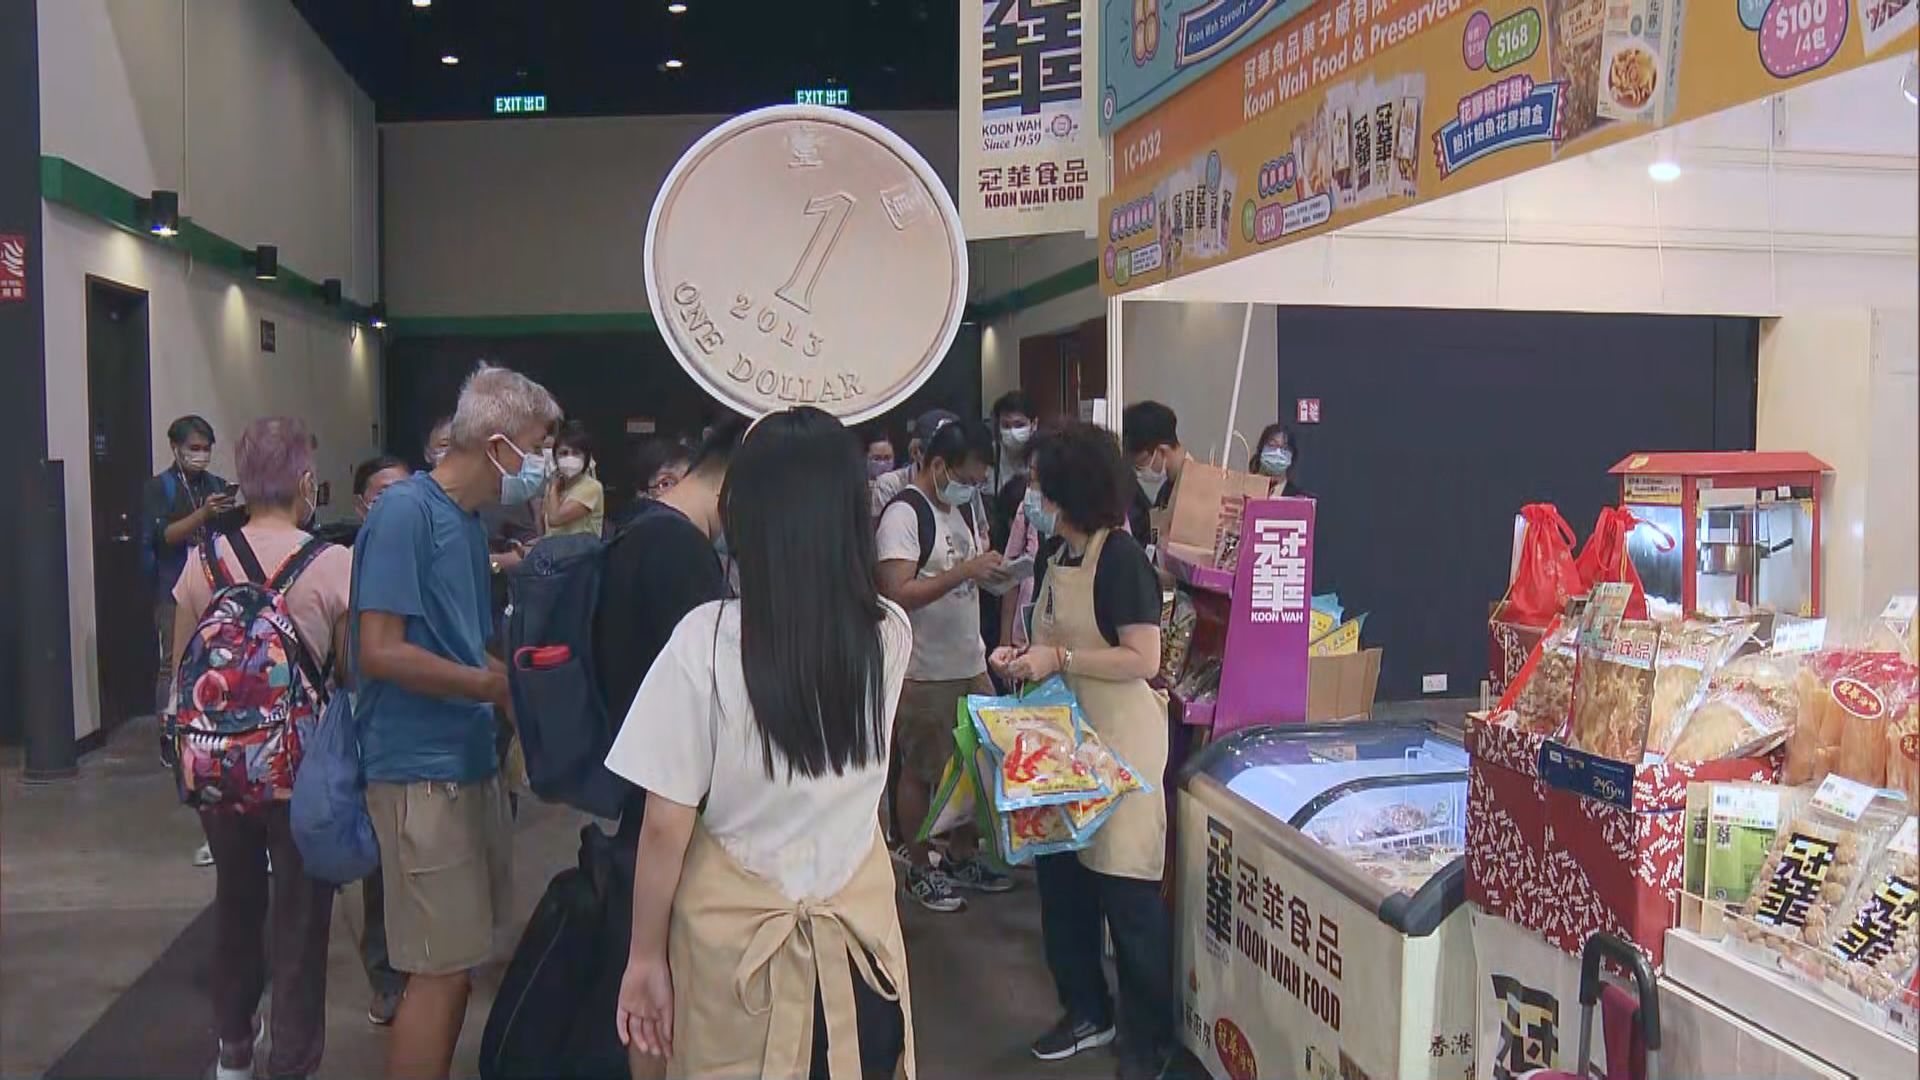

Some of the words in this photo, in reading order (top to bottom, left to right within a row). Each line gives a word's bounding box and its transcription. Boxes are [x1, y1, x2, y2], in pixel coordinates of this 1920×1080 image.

[1775, 0, 1828, 40] $100
[1497, 24, 1529, 57] $168
[1244, 88, 1274, 121] Koon
[1278, 64, 1308, 102] Wah
[1312, 38, 1347, 86] Food
[1353, 34, 1364, 62] &
[496, 96, 521, 113] EXIT
[524, 96, 545, 111] 出口
[797, 90, 823, 104] EXIT
[826, 90, 848, 104] 出口
[982, 121, 1013, 137] KOON
[1016, 118, 1041, 132] WAH
[983, 137, 1010, 151] Since
[1014, 132, 1041, 148] 1959
[978, 158, 1088, 192] 冠華食品
[985, 190, 1017, 209] KOON
[1020, 187, 1049, 206] WAH
[1052, 185, 1084, 203] FOOD
[775, 192, 857, 315] 1
[730, 293, 825, 357] 2013
[674, 281, 725, 355] ONE
[726, 353, 864, 403] DOLLAR
[1251, 611, 1279, 623] KOON
[1281, 611, 1303, 623] WAH
[1236, 856, 1343, 981] 冠華食品
[1236, 918, 1268, 974] KOON
[1270, 944, 1301, 1000] WAH
[1303, 970, 1341, 1033] FOOD
